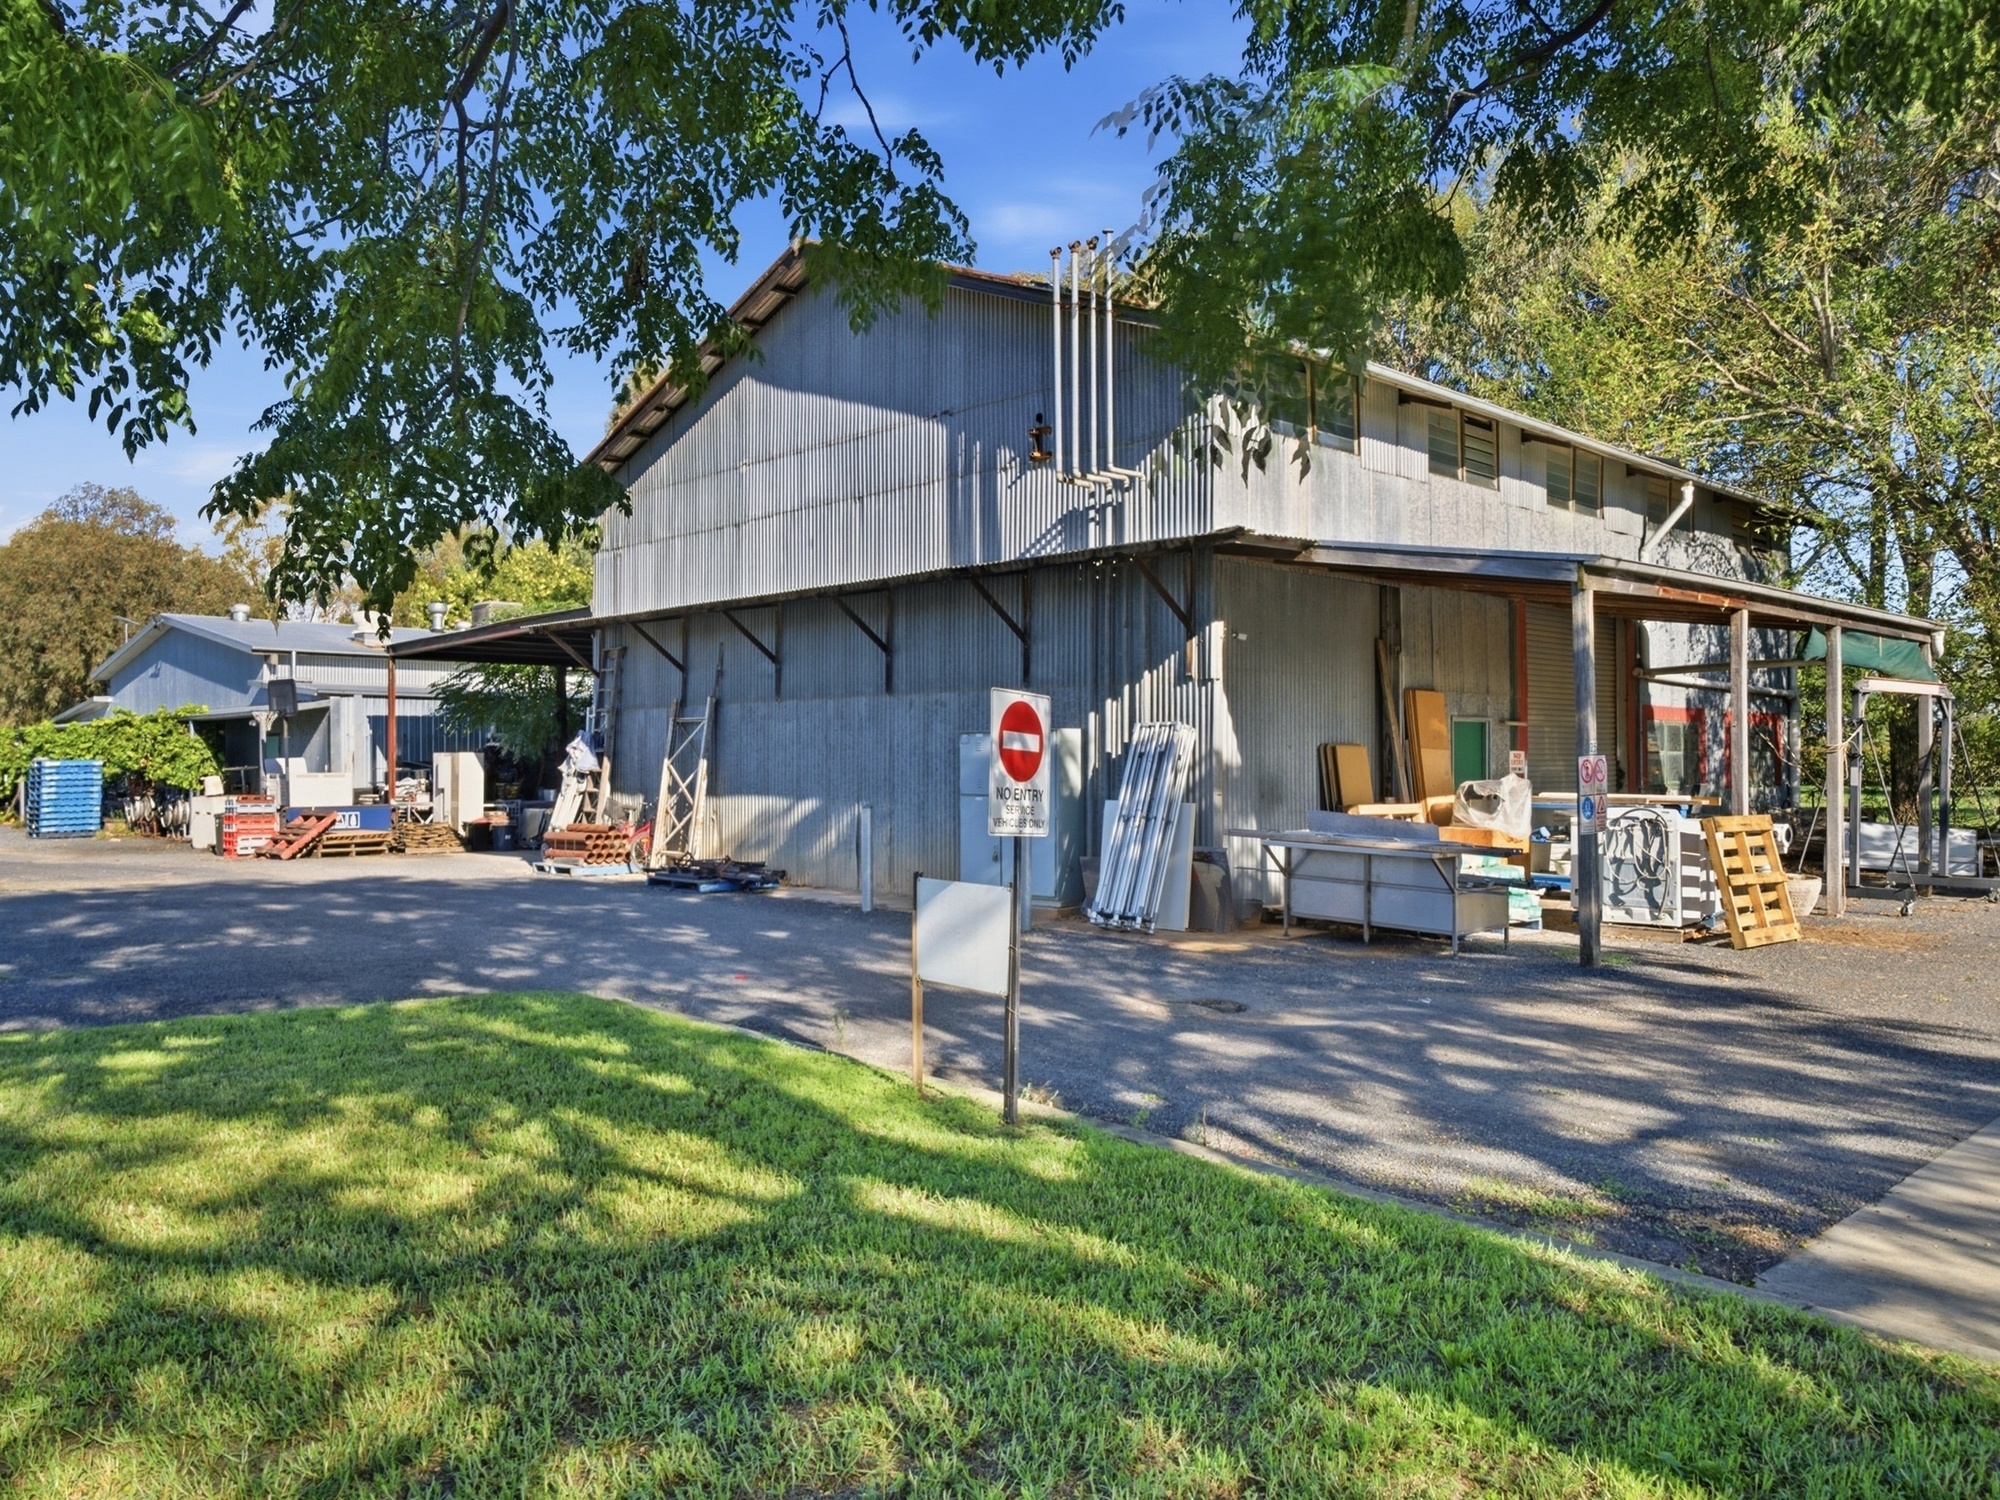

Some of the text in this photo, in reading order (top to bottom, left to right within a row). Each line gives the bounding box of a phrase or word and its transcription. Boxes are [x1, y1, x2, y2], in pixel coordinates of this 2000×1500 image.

[996, 787, 1044, 802] NO ENTRY
[1006, 805, 1035, 816] SERVICE
[993, 818, 1045, 829] VEHCLES ONLY
